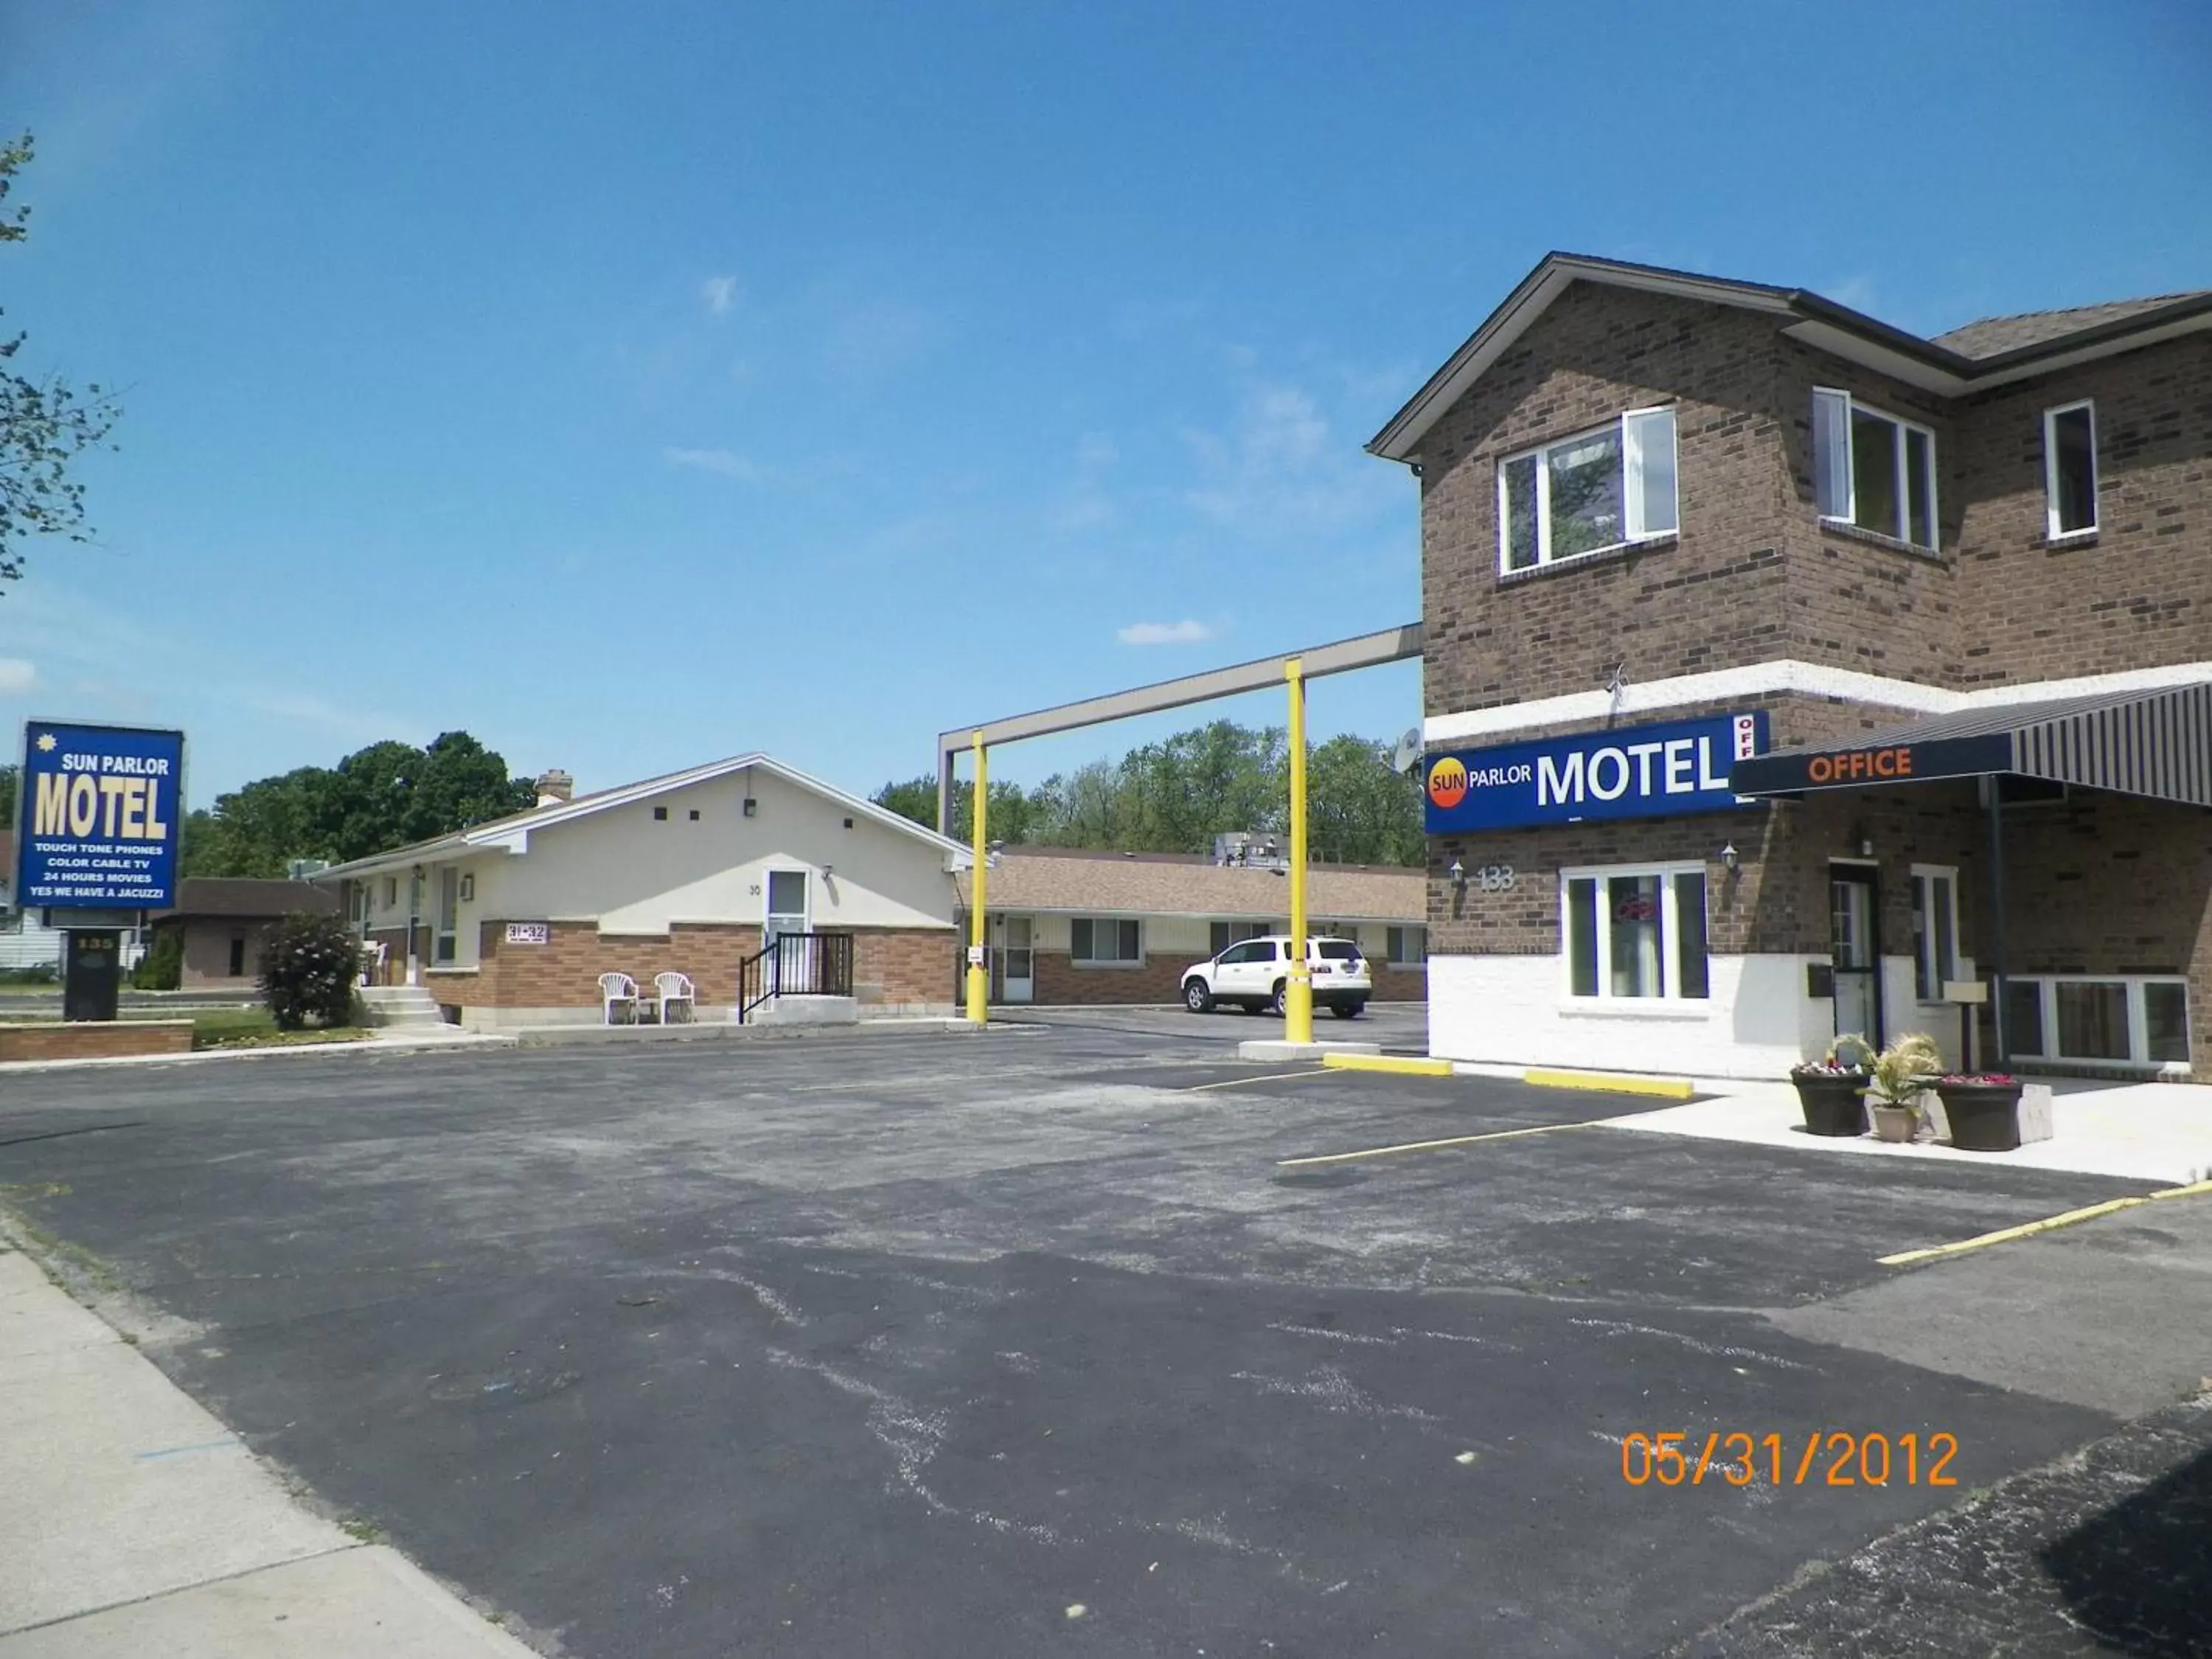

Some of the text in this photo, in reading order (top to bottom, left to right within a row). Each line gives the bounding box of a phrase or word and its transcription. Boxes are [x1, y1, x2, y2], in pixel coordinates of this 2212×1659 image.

[62, 754, 168, 775] SUN PARLOR
[1433, 736, 1729, 806] SUN PARLOR MOTEL
[1809, 748, 1912, 782] OFFICE
[35, 772, 167, 840] MOTEL
[35, 843, 164, 855] TOUCH TONE PHONES
[47, 858, 150, 869] COLOR CABLE TV
[44, 872, 153, 883] 24 HOURS MOVIES
[1478, 864, 1514, 890] 133
[29, 886, 164, 899] YES WE HAVE A JACUZZI
